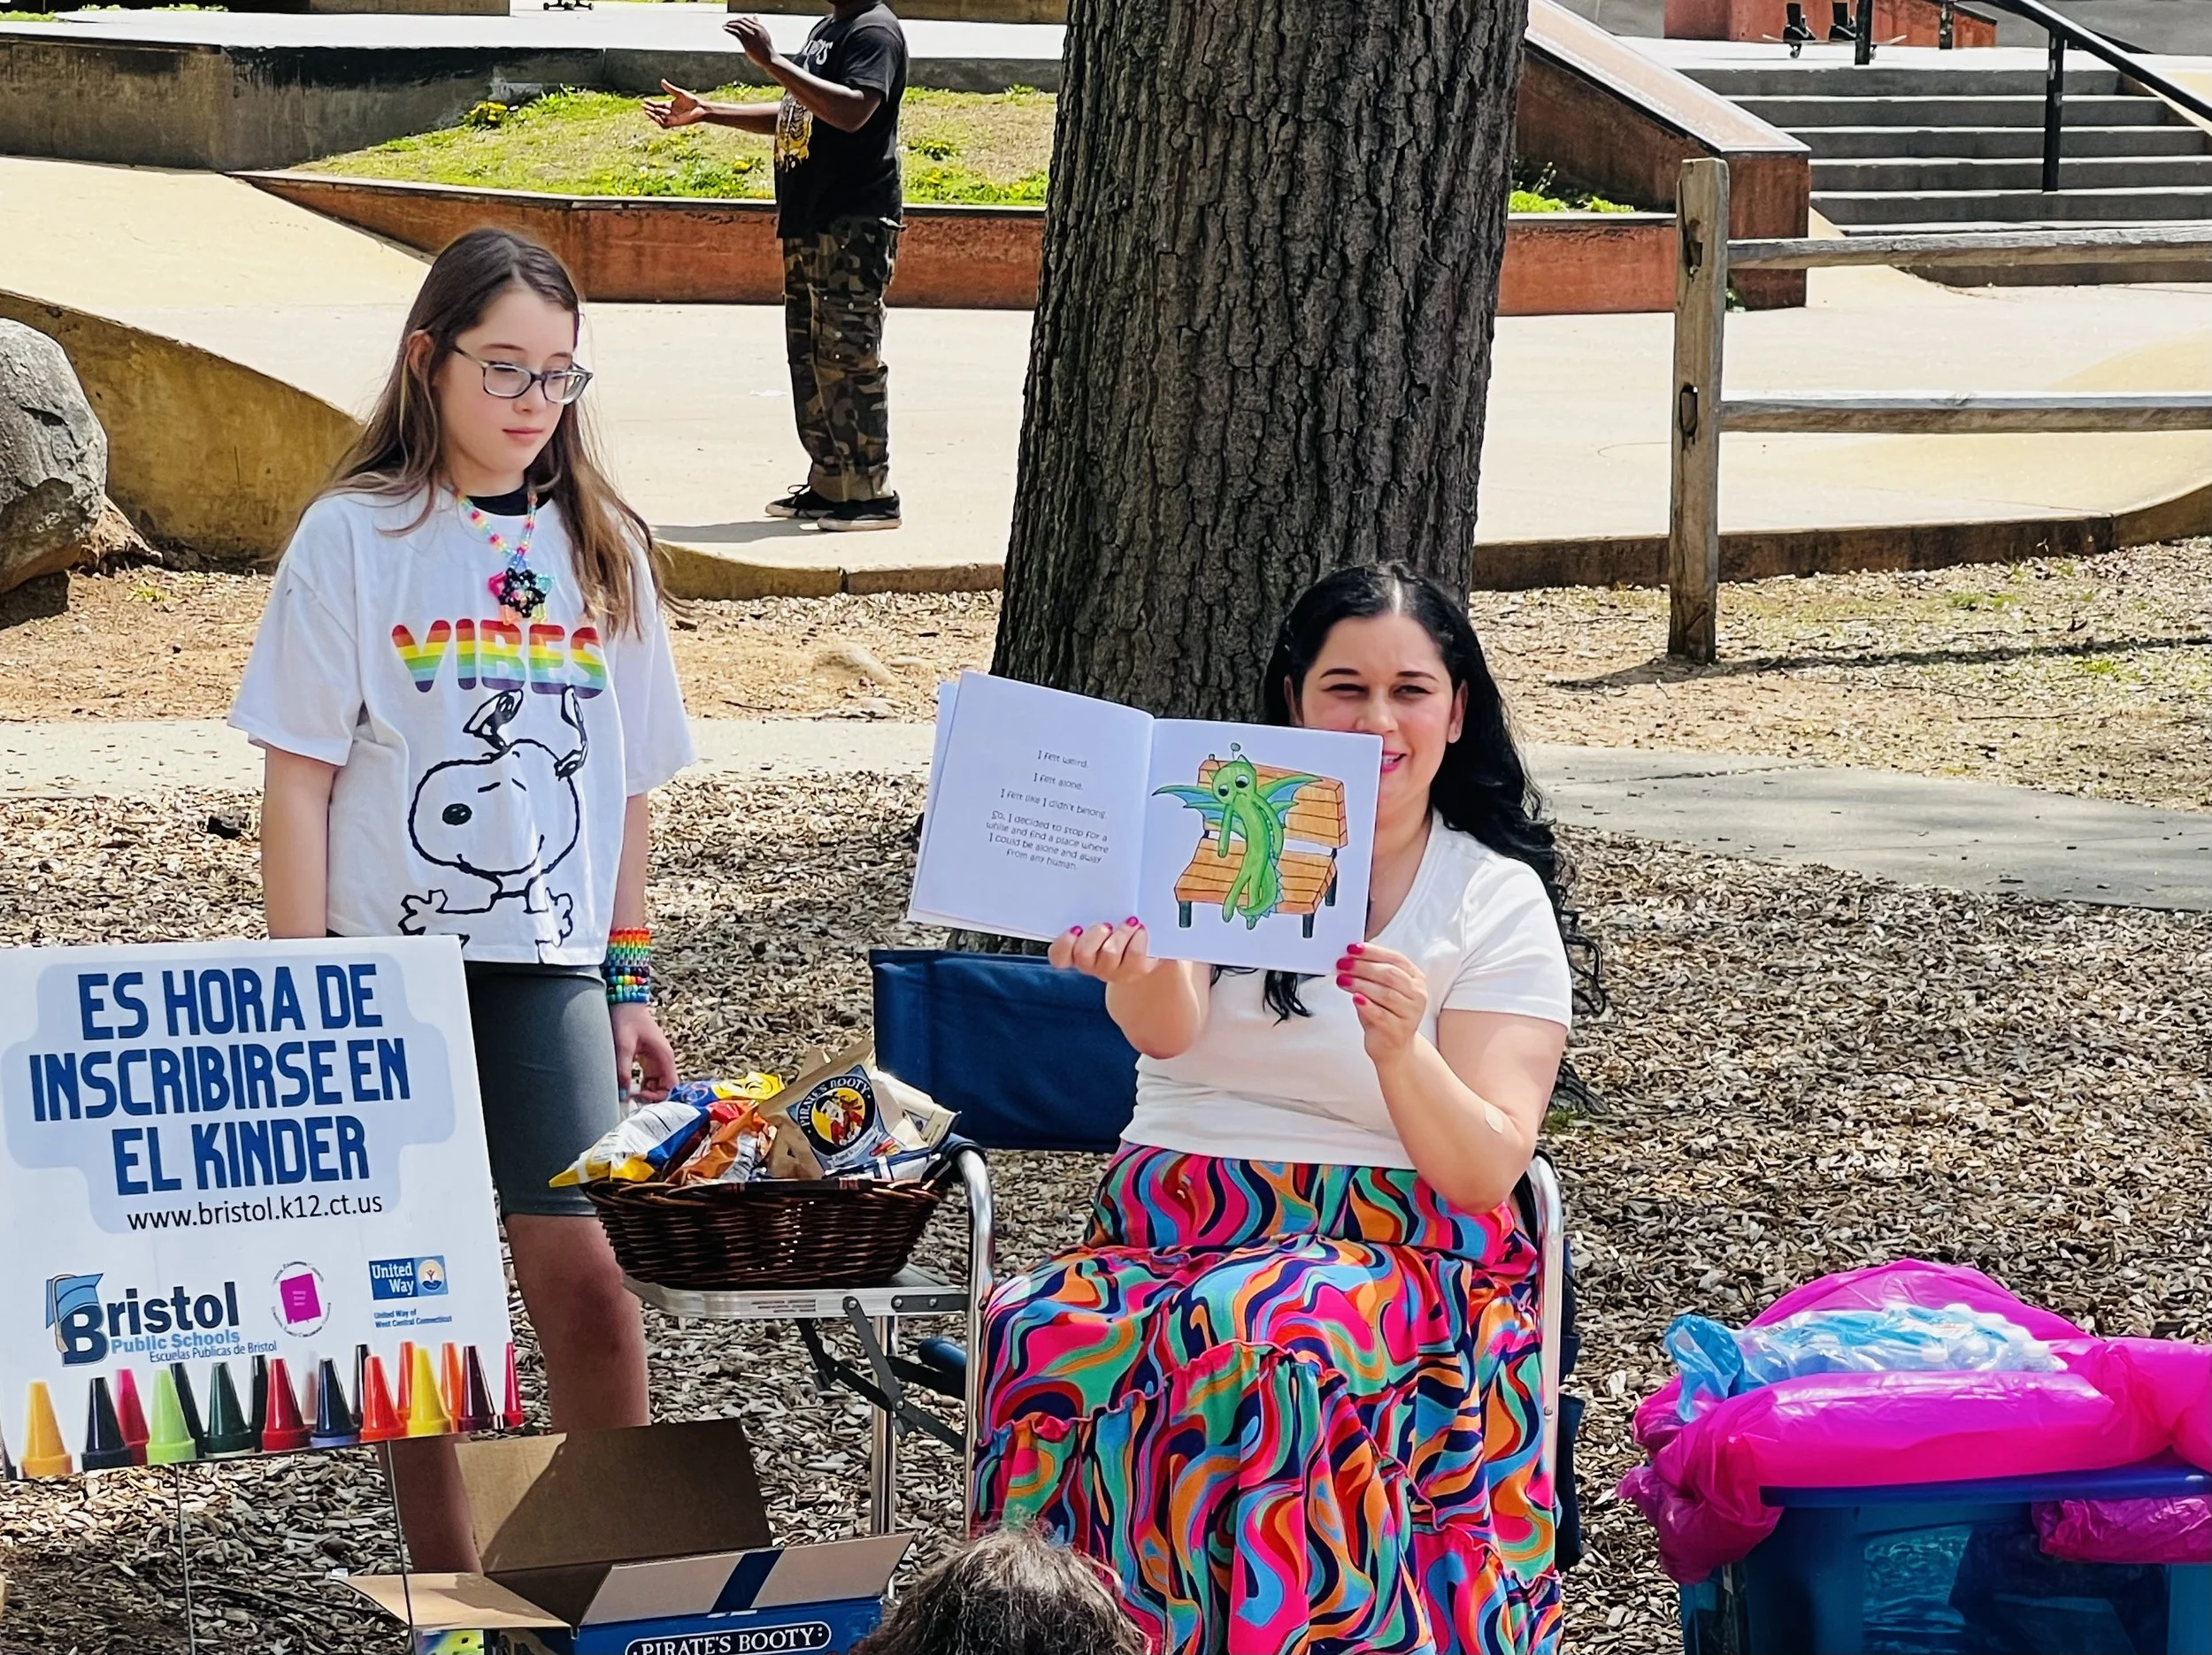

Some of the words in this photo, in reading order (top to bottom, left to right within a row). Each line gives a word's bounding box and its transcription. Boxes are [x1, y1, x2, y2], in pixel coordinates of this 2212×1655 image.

[392, 618, 607, 699] VIBES
[1038, 749, 1042, 760] I
[1043, 752, 1060, 762] felt
[1033, 772, 1038, 782] I
[1039, 774, 1056, 785] felt
[1001, 788, 1005, 798] I
[1007, 790, 1023, 801] felt
[1025, 794, 1041, 804] like
[1042, 798, 1047, 808] I
[1048, 800, 1074, 811] didn't
[986, 822, 1009, 832] while
[1010, 827, 1027, 837] and
[1029, 830, 1047, 840] find
[1056, 837, 1080, 847] place
[1081, 842, 1110, 854] where
[1008, 813, 1012, 824] I
[1014, 816, 1049, 830] decided
[1052, 824, 1062, 832] to
[1064, 826, 1084, 837] stop
[1086, 831, 1100, 839] for
[989, 831, 994, 842] I
[995, 834, 1021, 847] could
[1022, 840, 1033, 849] be
[1035, 844, 1059, 854] alone
[1060, 848, 1078, 859] and
[1006, 848, 1028, 859] from
[1029, 854, 1045, 863] any
[78, 972, 150, 1041] ES
[162, 966, 306, 1037] HORA
[316, 963, 382, 1030] DE
[29, 1039, 342, 1122] INSCRIBIRSE
[347, 1038, 411, 1102] EN
[111, 1127, 182, 1196] EL
[191, 1115, 370, 1190] KINDER
[127, 1194, 383, 1231] www.bristol.k12.ct.us
[372, 1261, 413, 1279] United
[389, 1278, 414, 1296] Way
[58, 1282, 240, 1366] Bristol
[111, 1337, 167, 1354] Public
[171, 1329, 241, 1350] Schools
[150, 1345, 190, 1363] Escuelas
[234, 1344, 245, 1356] de
[248, 1340, 277, 1354] Bristol
[641, 1636, 731, 1655] PIRATE'S
[738, 1627, 814, 1652] BOOTY
